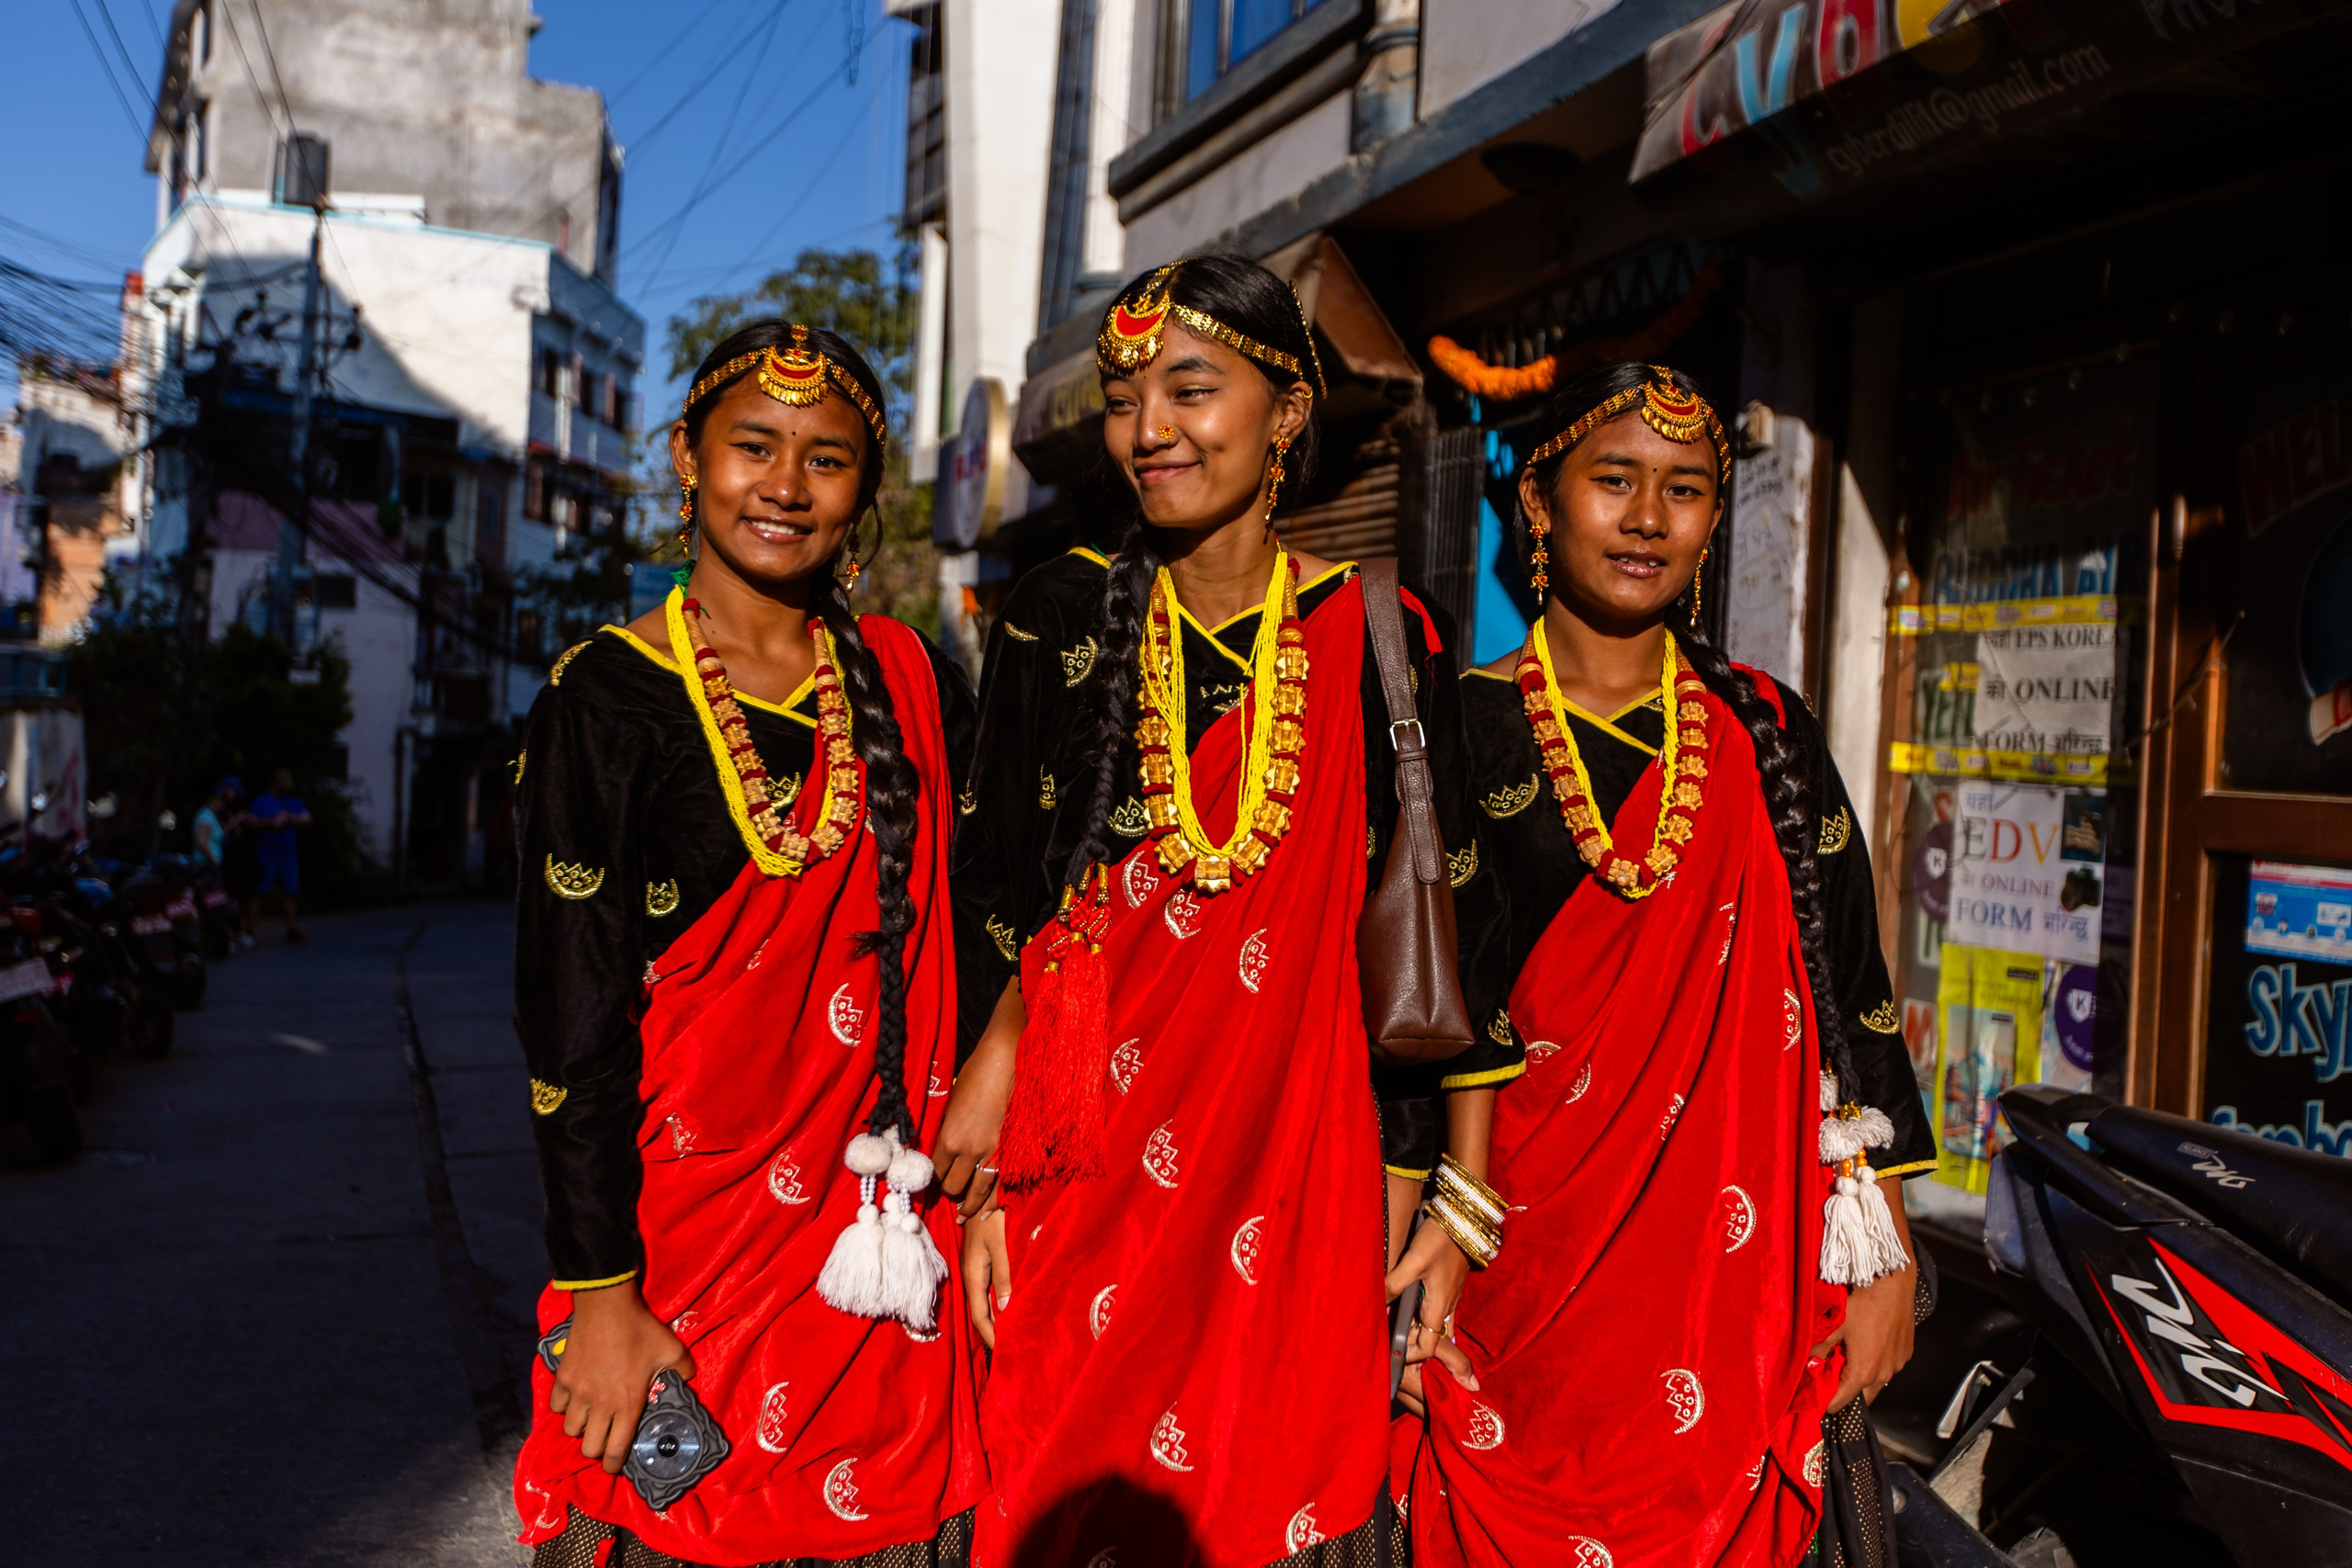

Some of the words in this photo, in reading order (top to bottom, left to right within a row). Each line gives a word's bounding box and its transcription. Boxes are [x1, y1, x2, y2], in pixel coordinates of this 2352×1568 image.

[2010, 417, 2138, 509] Ticket
[2016, 626, 2048, 649] EPS
[1984, 730, 2045, 751] FORM
[1964, 817, 2061, 865] EDV
[1982, 873, 2055, 899] ONLINE
[1957, 897, 2033, 931] FORM
